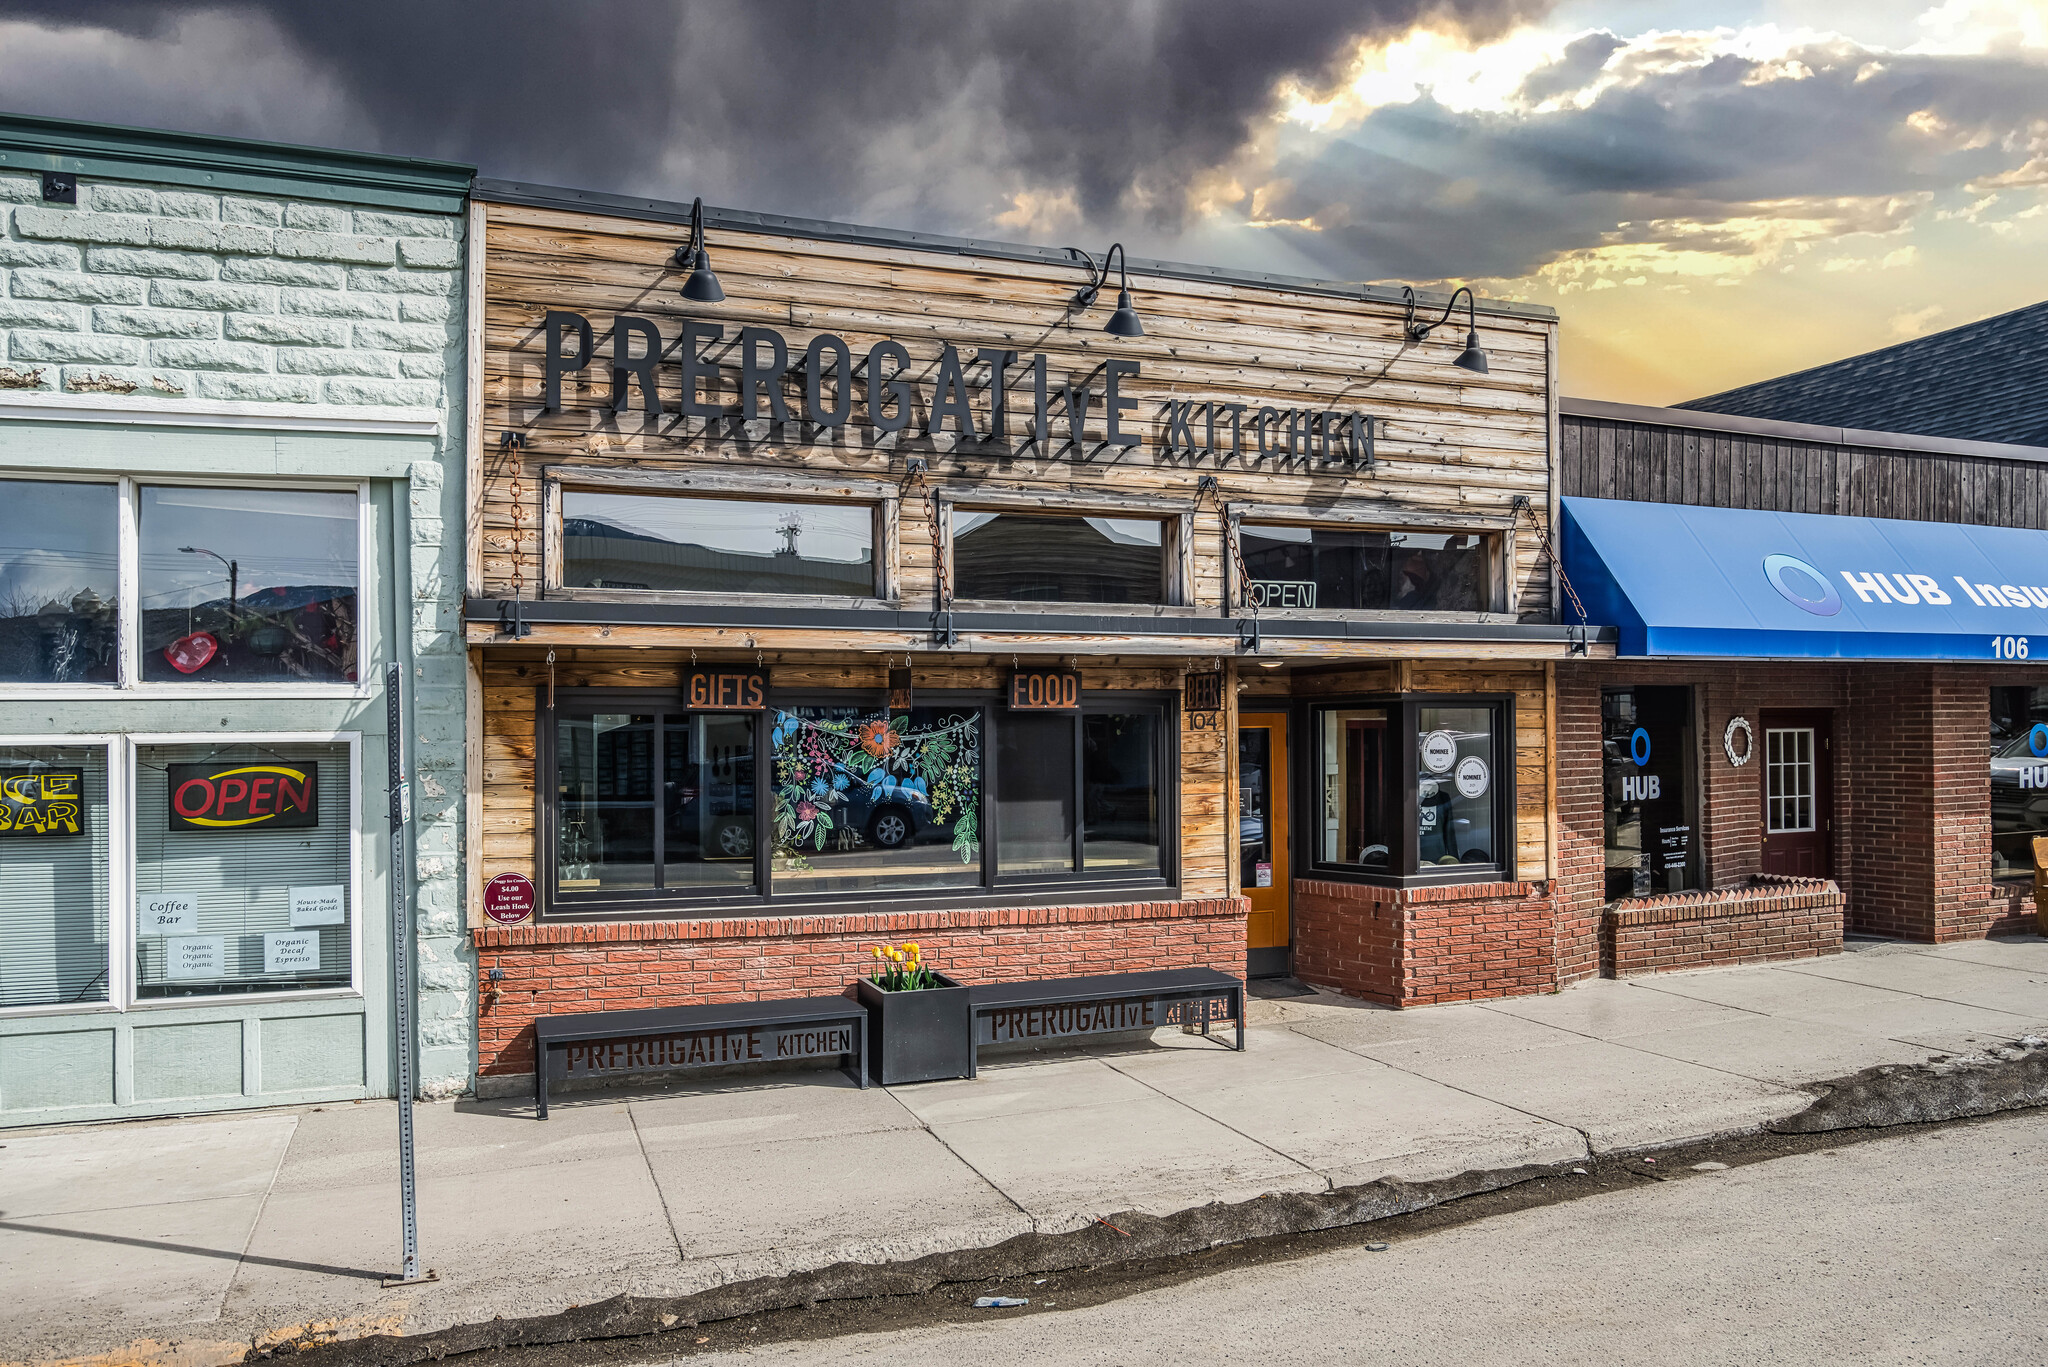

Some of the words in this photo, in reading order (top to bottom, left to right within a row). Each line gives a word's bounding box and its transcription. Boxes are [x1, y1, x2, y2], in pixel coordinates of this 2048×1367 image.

[1170, 399, 1374, 465] KITCHEN
[1250, 583, 1313, 608] OPEN
[1840, 570, 1952, 606] HUB
[1991, 636, 2029, 660] 106
[690, 673, 764, 707] GIFTS
[1014, 673, 1077, 707] FOOD
[1187, 675, 1219, 707] BEER
[1188, 711, 1218, 731] 104
[1622, 775, 1661, 801] HUB
[174, 777, 312, 818] OPEN
[501, 885, 519, 893] $4.00
[149, 900, 189, 914] Coffee
[296, 897, 338, 906] House-Made
[296, 905, 317, 913] Baked
[318, 904, 338, 912] Goods
[156, 915, 182, 925] Bar
[182, 944, 214, 952] Organic
[275, 938, 309, 947] Organic
[280, 946, 306, 955] Decaf
[182, 953, 214, 961] Organic
[182, 961, 214, 970] Organic
[274, 956, 310, 965] Espresso
[777, 1029, 851, 1057] KITCHEN
